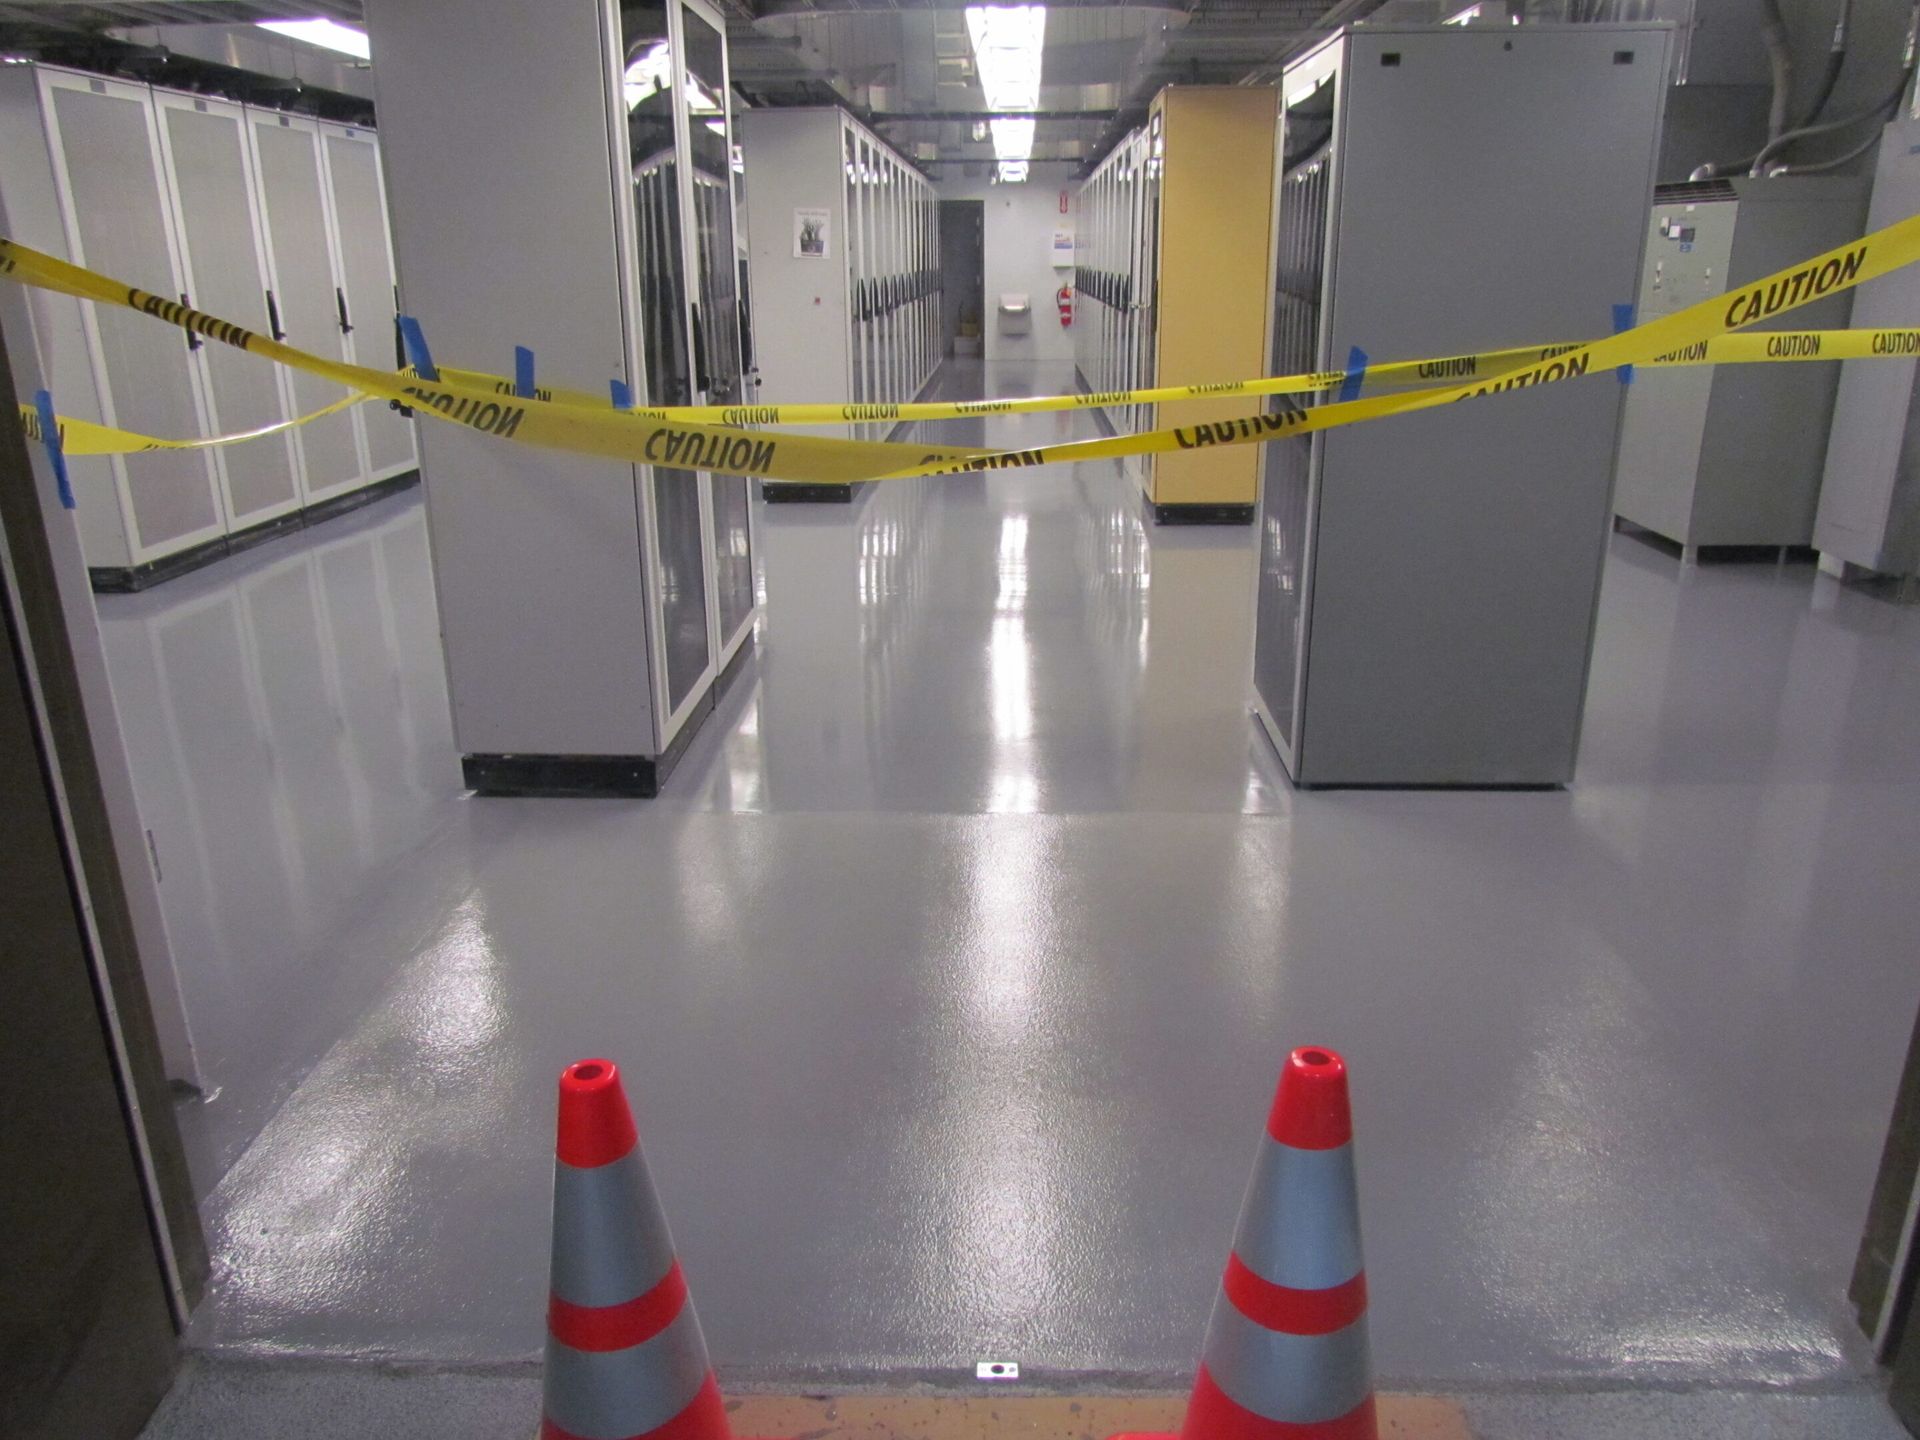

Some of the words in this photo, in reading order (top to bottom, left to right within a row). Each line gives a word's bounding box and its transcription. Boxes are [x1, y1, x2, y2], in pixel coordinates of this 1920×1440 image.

[1725, 246, 1868, 328] CAUTION
[1767, 335, 1821, 357] CAUTION
[1419, 357, 1477, 379] CAUTION
